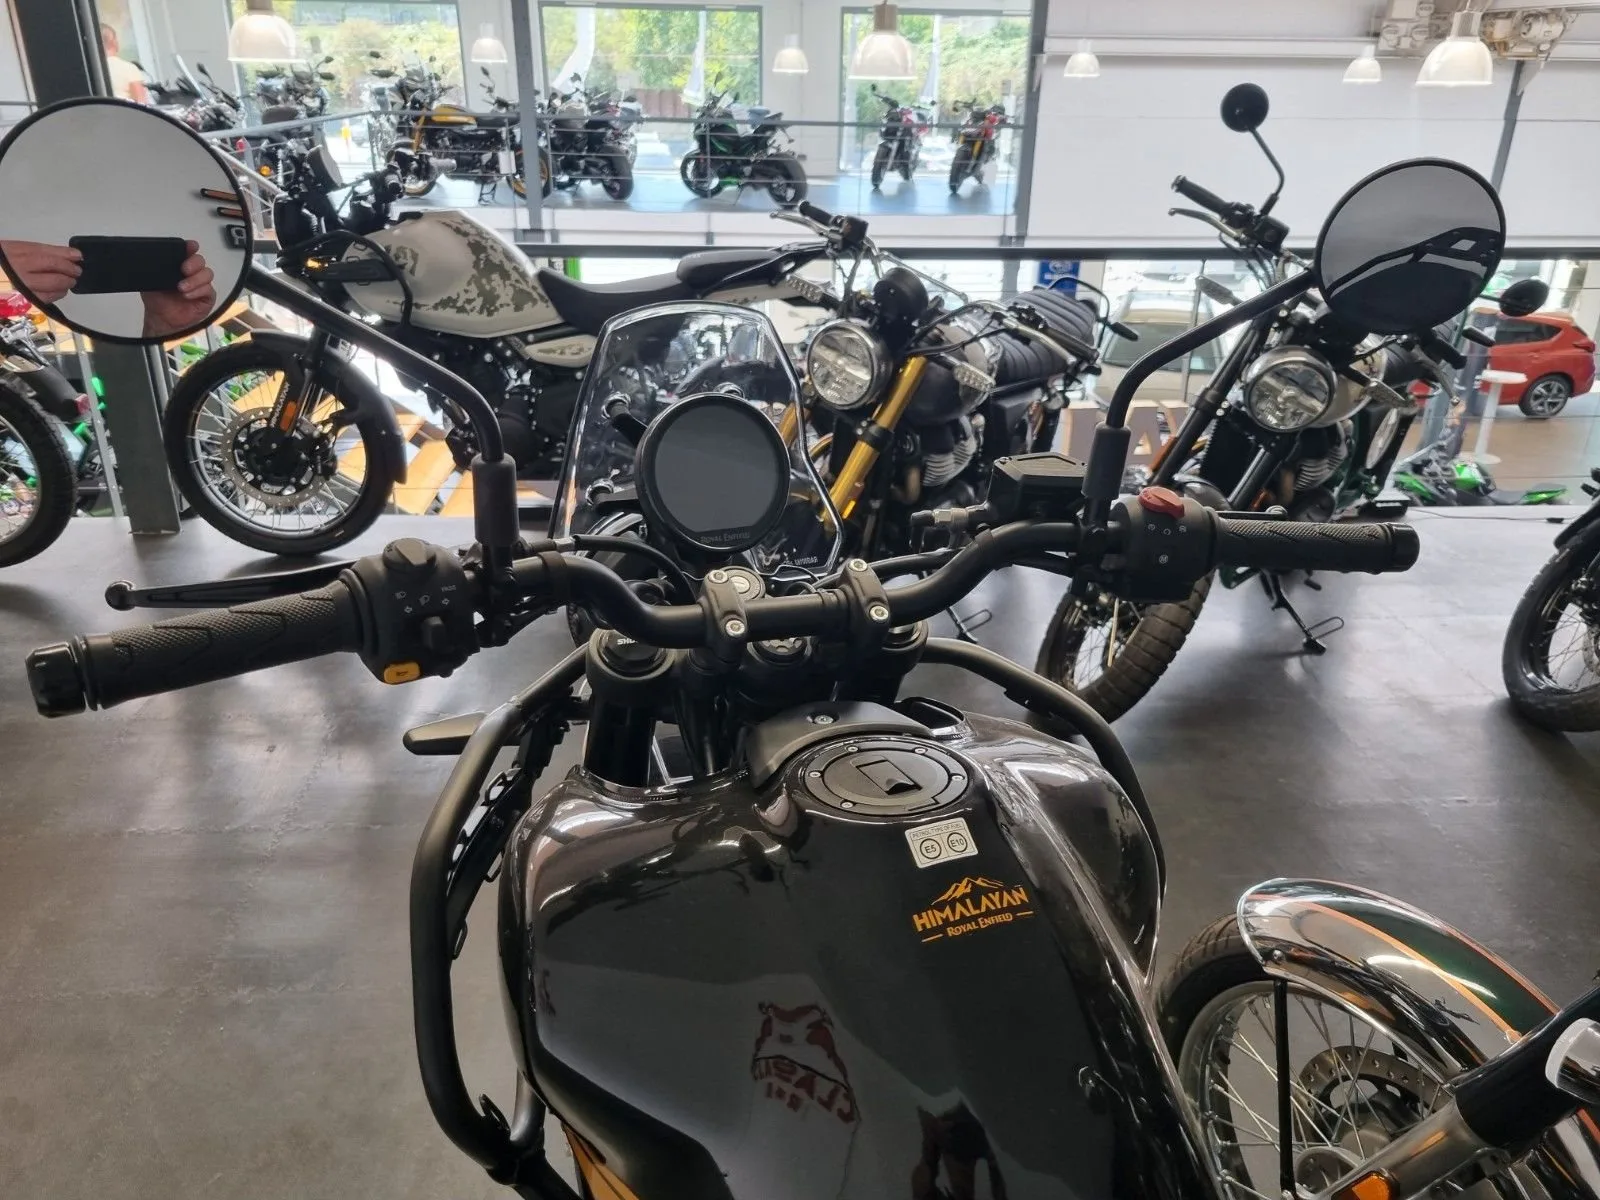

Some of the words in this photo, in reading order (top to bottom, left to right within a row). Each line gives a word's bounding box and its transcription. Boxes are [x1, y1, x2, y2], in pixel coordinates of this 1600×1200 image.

[924, 845, 937, 854] E5
[950, 838, 965, 848] E10
[912, 887, 1029, 932] HIMALAYAN
[946, 921, 979, 937] ROYAL
[978, 912, 1013, 929] ENFIELD
